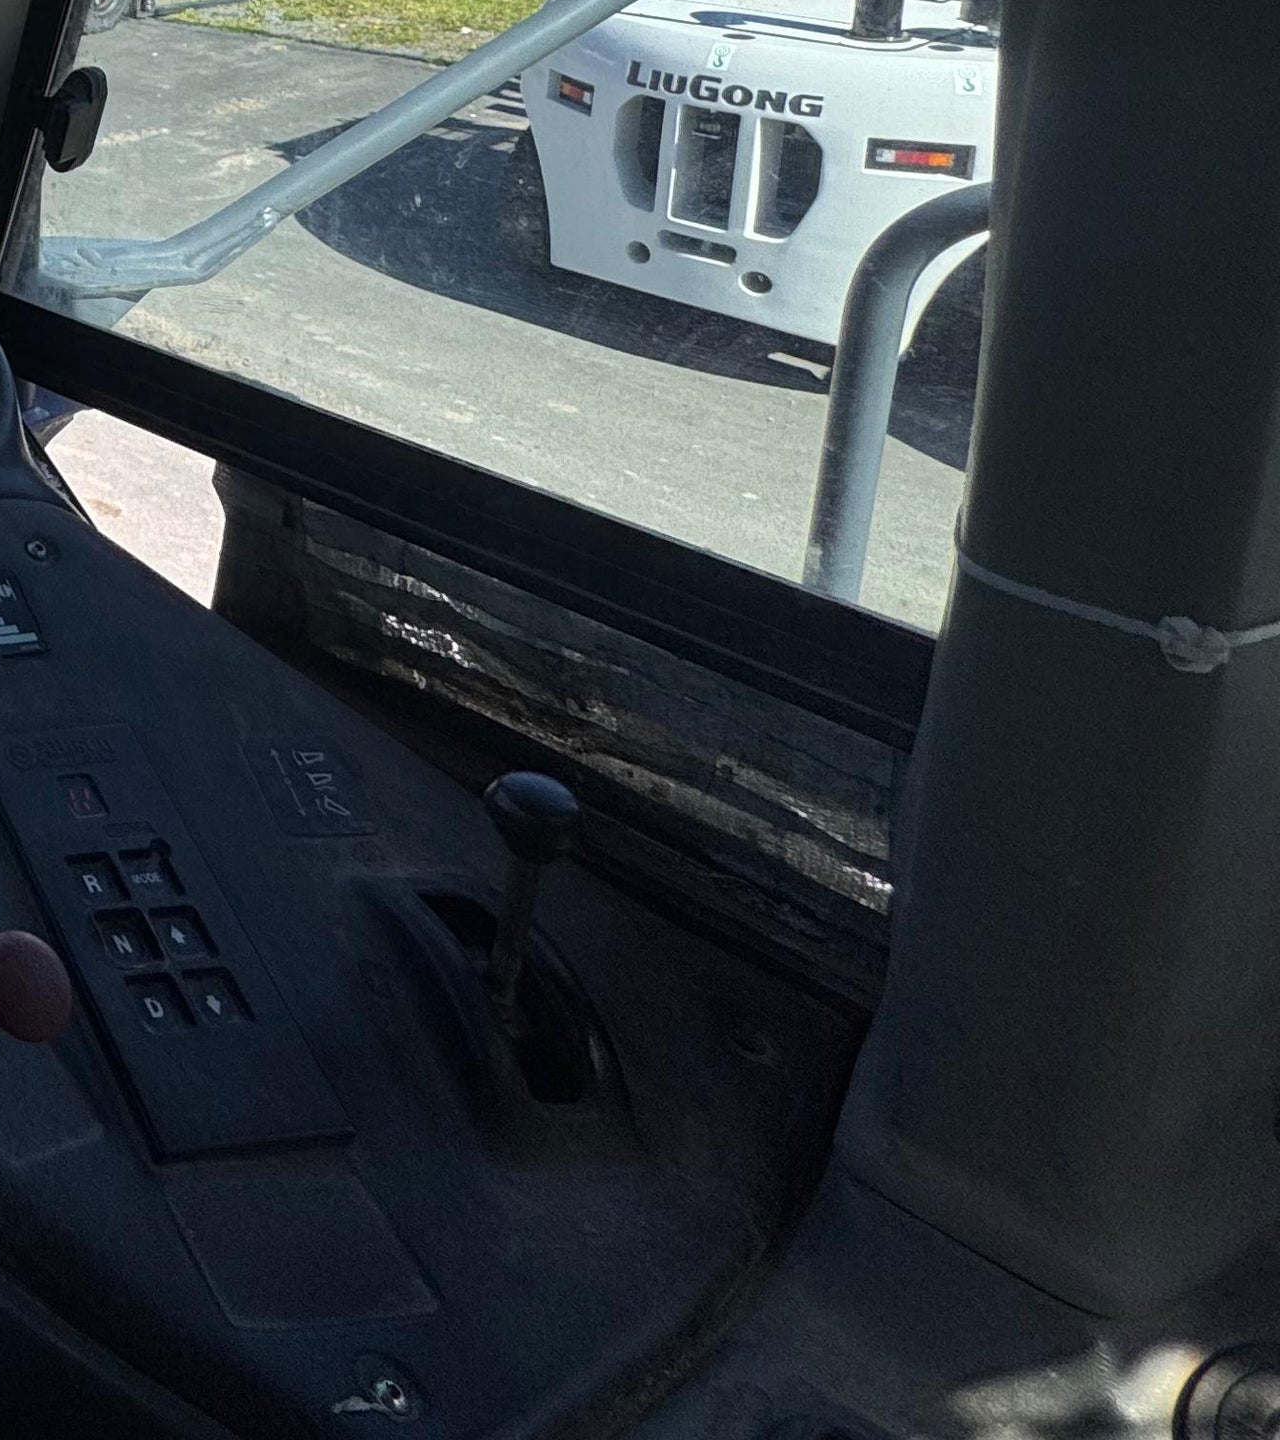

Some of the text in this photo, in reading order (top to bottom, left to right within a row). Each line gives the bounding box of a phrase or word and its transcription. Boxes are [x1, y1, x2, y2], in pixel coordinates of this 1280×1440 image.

[82, 873, 102, 893] R
[112, 934, 133, 954] N
[144, 997, 164, 1018] D
